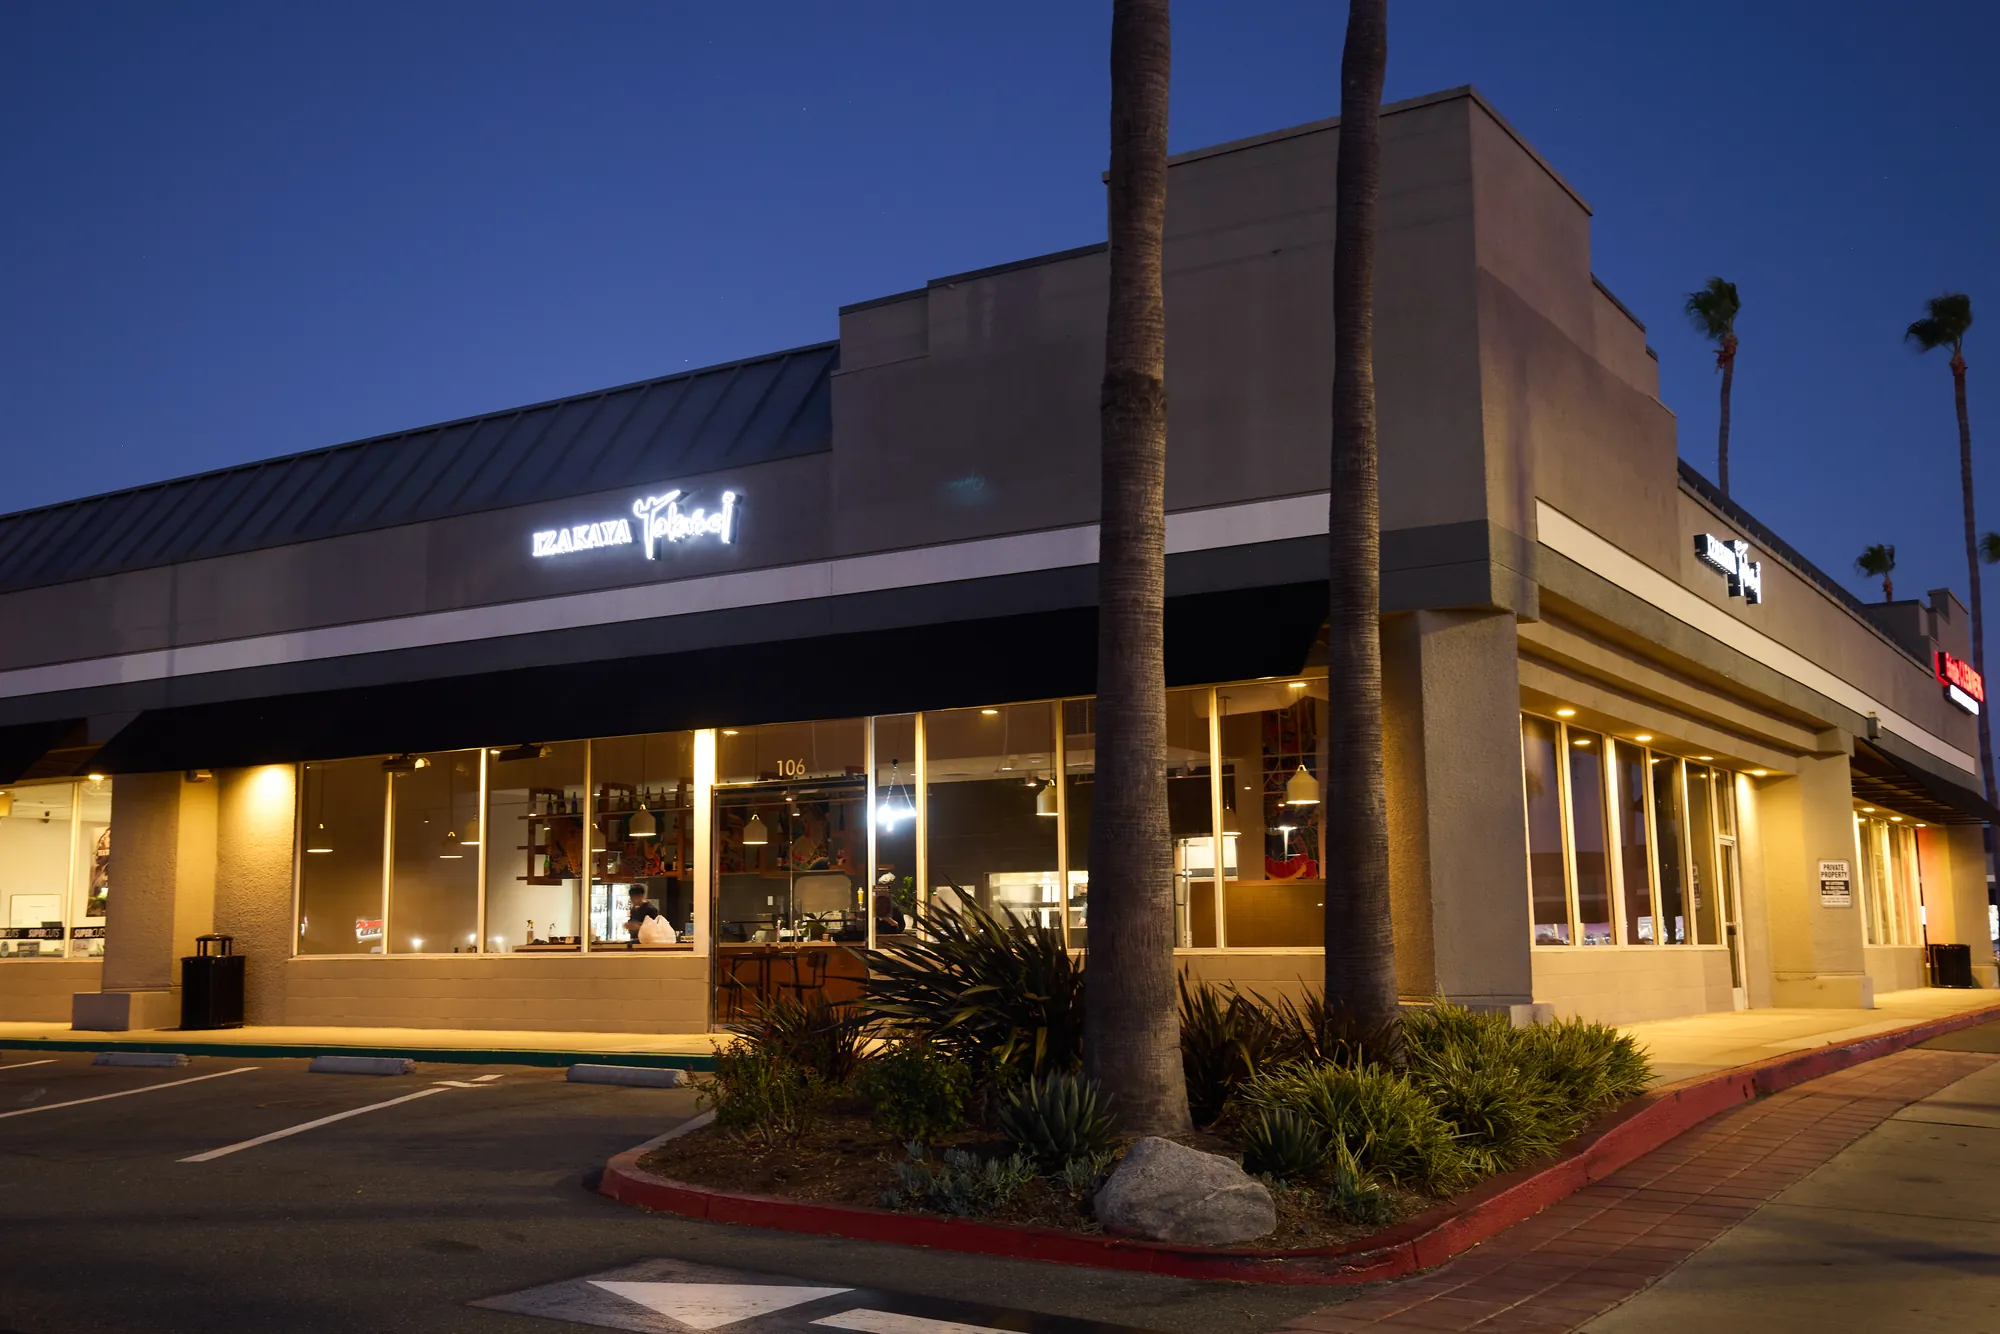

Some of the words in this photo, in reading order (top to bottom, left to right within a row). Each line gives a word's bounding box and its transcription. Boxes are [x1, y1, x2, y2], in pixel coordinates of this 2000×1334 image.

[532, 518, 632, 557] IZAKAYA
[777, 758, 805, 776] 106
[28, 928, 61, 938] SUPERCUTS
